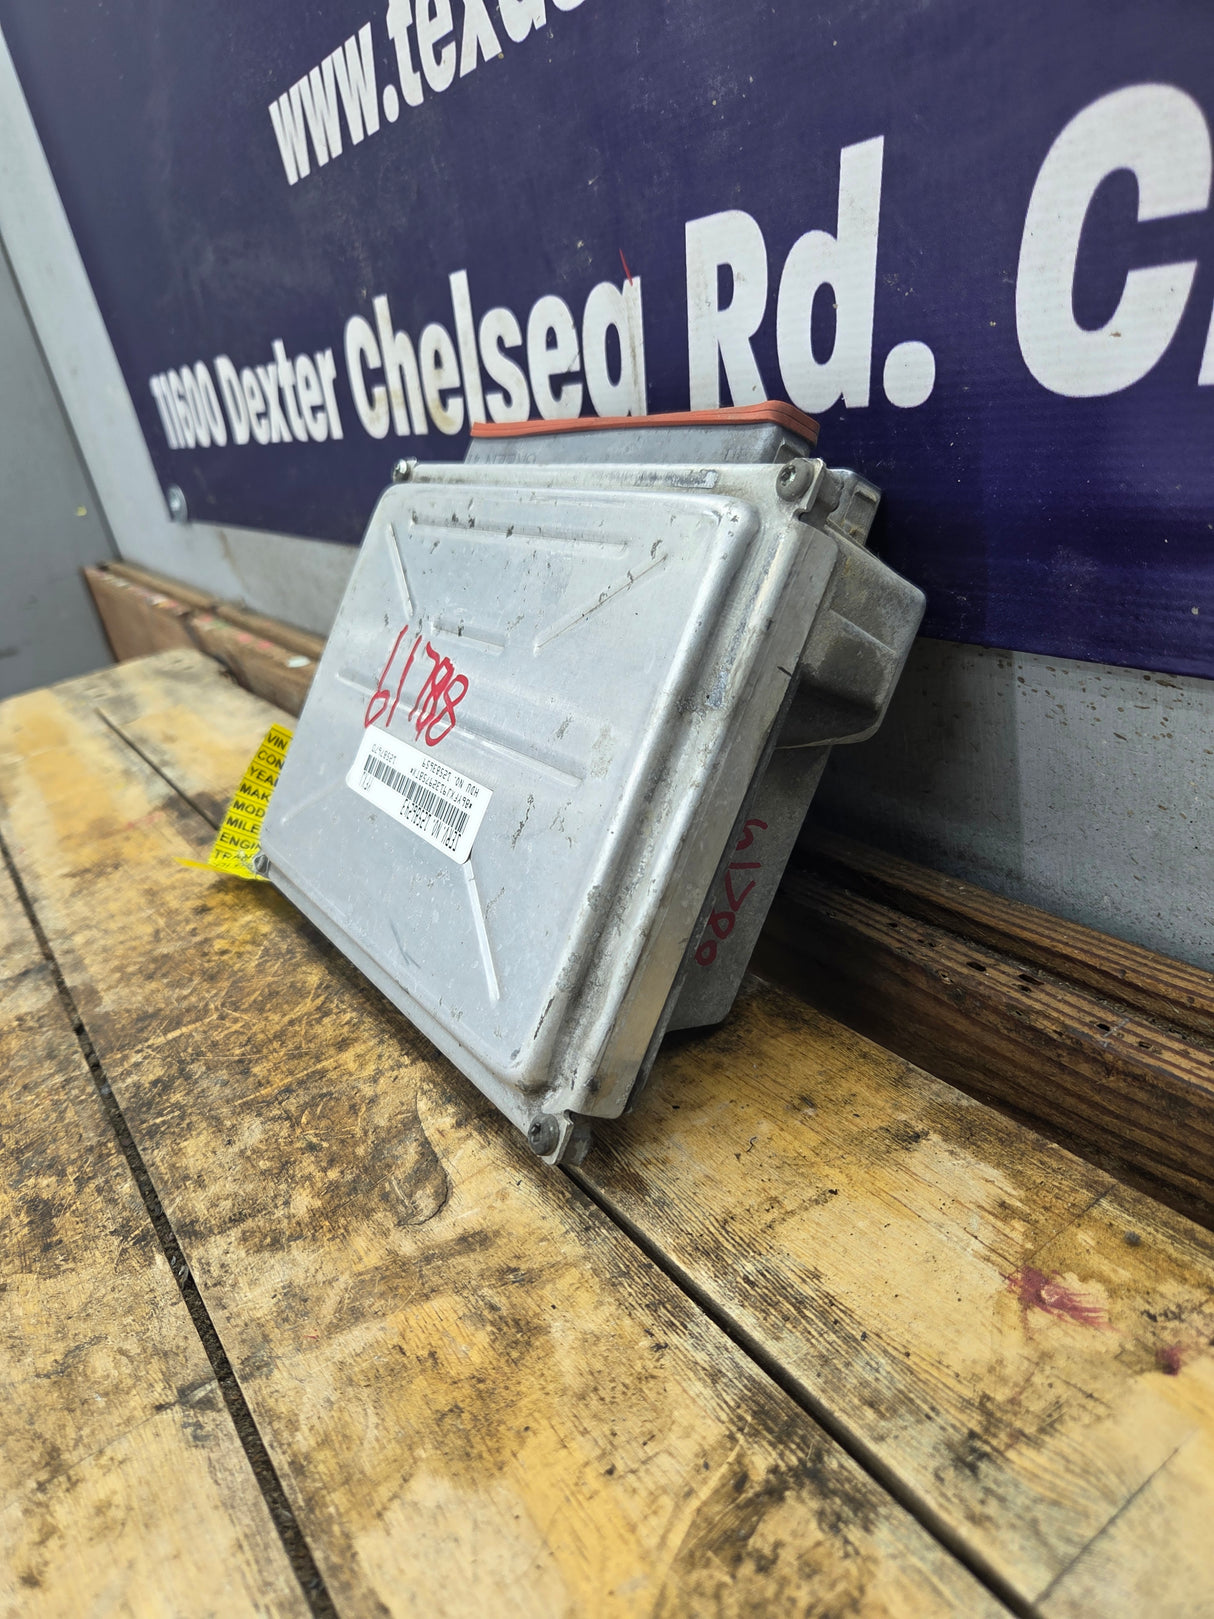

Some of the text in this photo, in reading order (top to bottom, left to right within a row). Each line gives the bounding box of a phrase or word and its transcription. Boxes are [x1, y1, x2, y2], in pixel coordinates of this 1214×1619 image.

[150, 82, 1214, 450] 11600 Dexter Chelsea Rd. C
[267, 732, 289, 751] VIN
[226, 816, 261, 836] MILE
